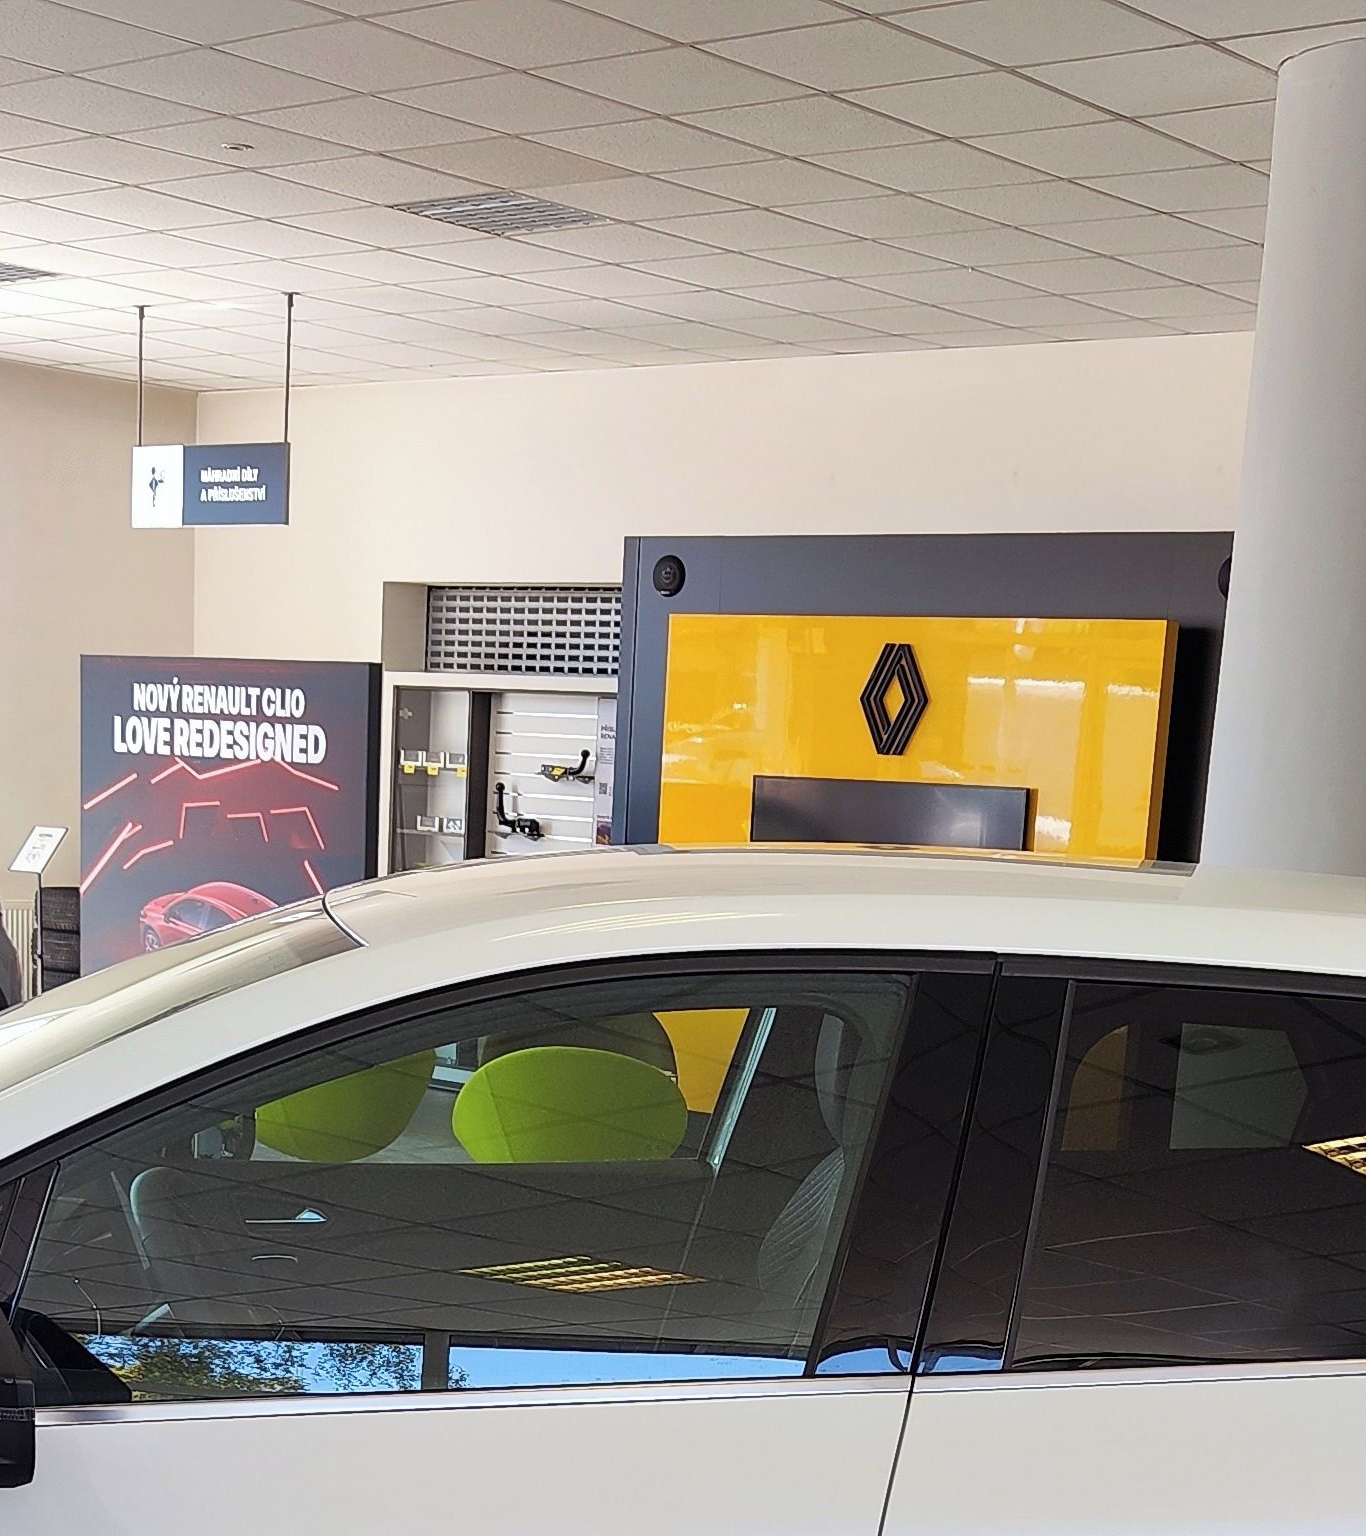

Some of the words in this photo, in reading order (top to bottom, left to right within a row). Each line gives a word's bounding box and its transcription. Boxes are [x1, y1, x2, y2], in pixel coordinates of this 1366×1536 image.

[200, 488, 208, 502] A
[133, 676, 181, 713] NOVÝ
[181, 684, 260, 716] RENAULT
[262, 687, 306, 719] CLIO
[113, 715, 171, 756] LOVE
[173, 718, 327, 764] REDESIGNED
